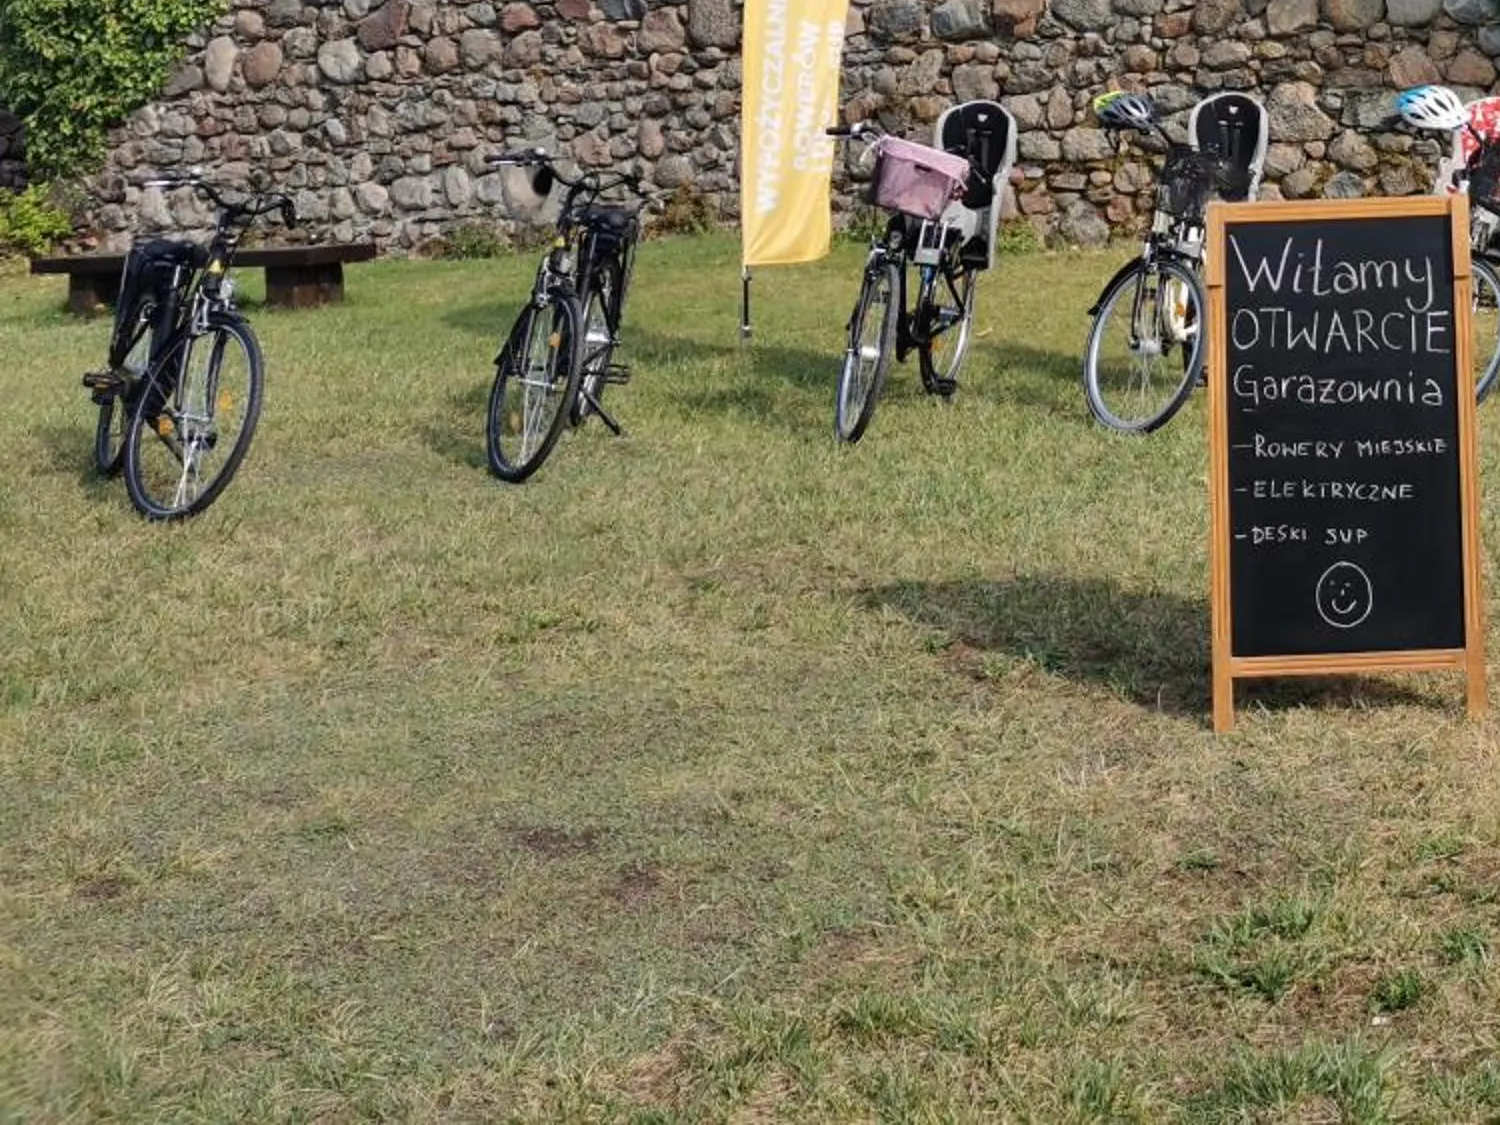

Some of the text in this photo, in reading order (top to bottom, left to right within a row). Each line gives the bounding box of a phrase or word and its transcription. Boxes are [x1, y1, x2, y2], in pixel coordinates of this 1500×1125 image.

[1229, 234, 1434, 313] Witamy
[1231, 307, 1451, 354] OTWARCIE
[1355, 437, 1448, 458] MIEJSKIE
[1324, 527, 1369, 545] SUP
